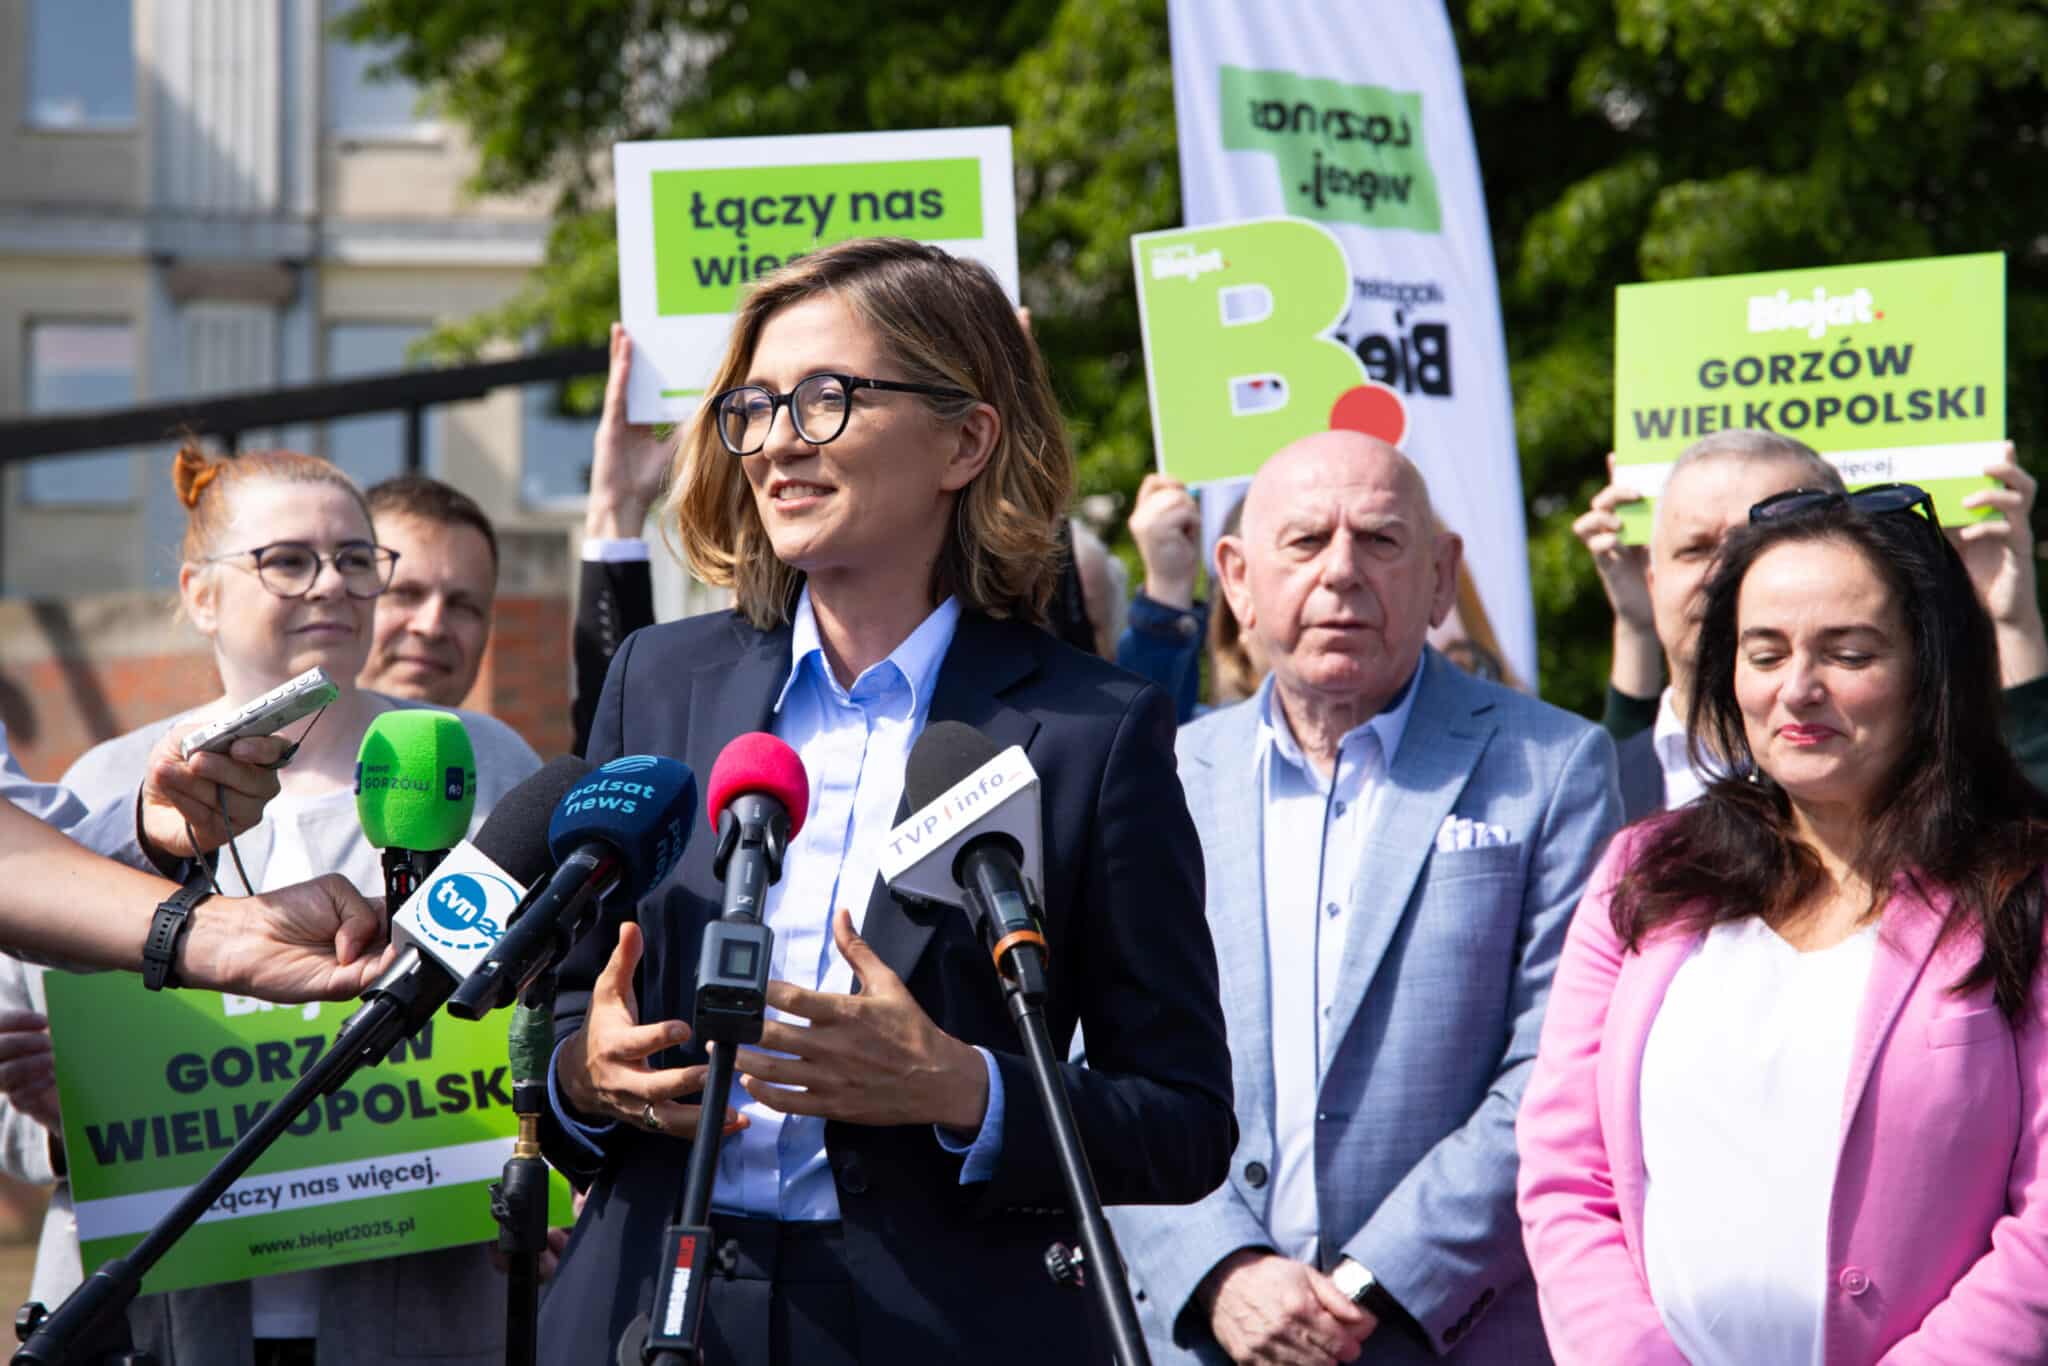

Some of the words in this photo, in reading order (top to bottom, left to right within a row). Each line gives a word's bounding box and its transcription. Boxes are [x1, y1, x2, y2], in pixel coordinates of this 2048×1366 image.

[689, 191, 836, 237] Łączy
[850, 188, 945, 223] nas
[1698, 337, 1915, 390] GORZÓW
[1633, 385, 1987, 440] WIELKOPOLSKI
[564, 779, 656, 806] polsat
[565, 796, 637, 817] news
[889, 815, 938, 856] TVP
[166, 1019, 434, 1094] GORZW
[86, 1066, 516, 1166] WIELKOPOLSK
[290, 1176, 341, 1199] nas
[347, 1155, 442, 1193] więcej.
[248, 1217, 416, 1257] www.biejat2025.pl
